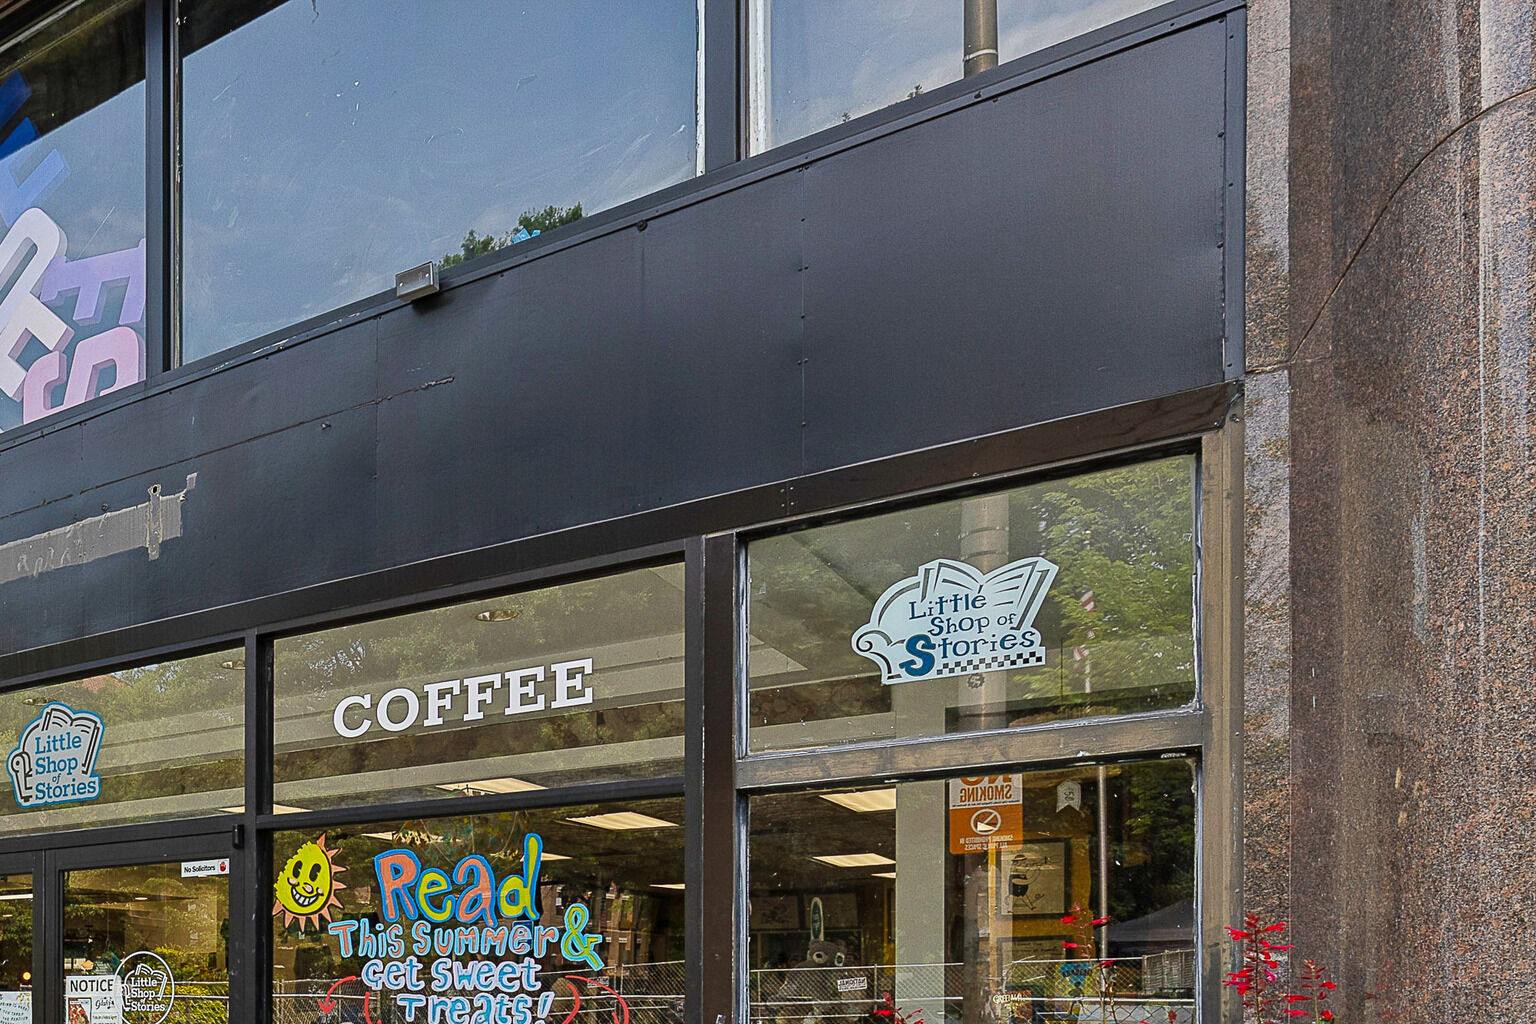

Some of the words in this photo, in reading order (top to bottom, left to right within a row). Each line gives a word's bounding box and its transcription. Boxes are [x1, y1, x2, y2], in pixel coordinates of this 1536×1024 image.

[909, 593, 987, 620] Little
[927, 616, 990, 637] Shop
[997, 613, 1017, 627] of
[899, 630, 1036, 677] Stories
[333, 657, 593, 738] COFFEE
[34, 732, 82, 755] Little
[35, 757, 78, 776] Shop
[34, 779, 96, 801] Stories
[51, 773, 61, 785] of
[192, 864, 216, 873] Solicitors
[374, 832, 543, 927] Read
[328, 918, 405, 958] This
[412, 920, 559, 958] Summer
[560, 902, 605, 971] &
[131, 977, 158, 988] Little
[431, 957, 542, 992] Sweet
[70, 979, 114, 993] NOTICE
[131, 988, 156, 999] Shop
[131, 1001, 165, 1012] Stories
